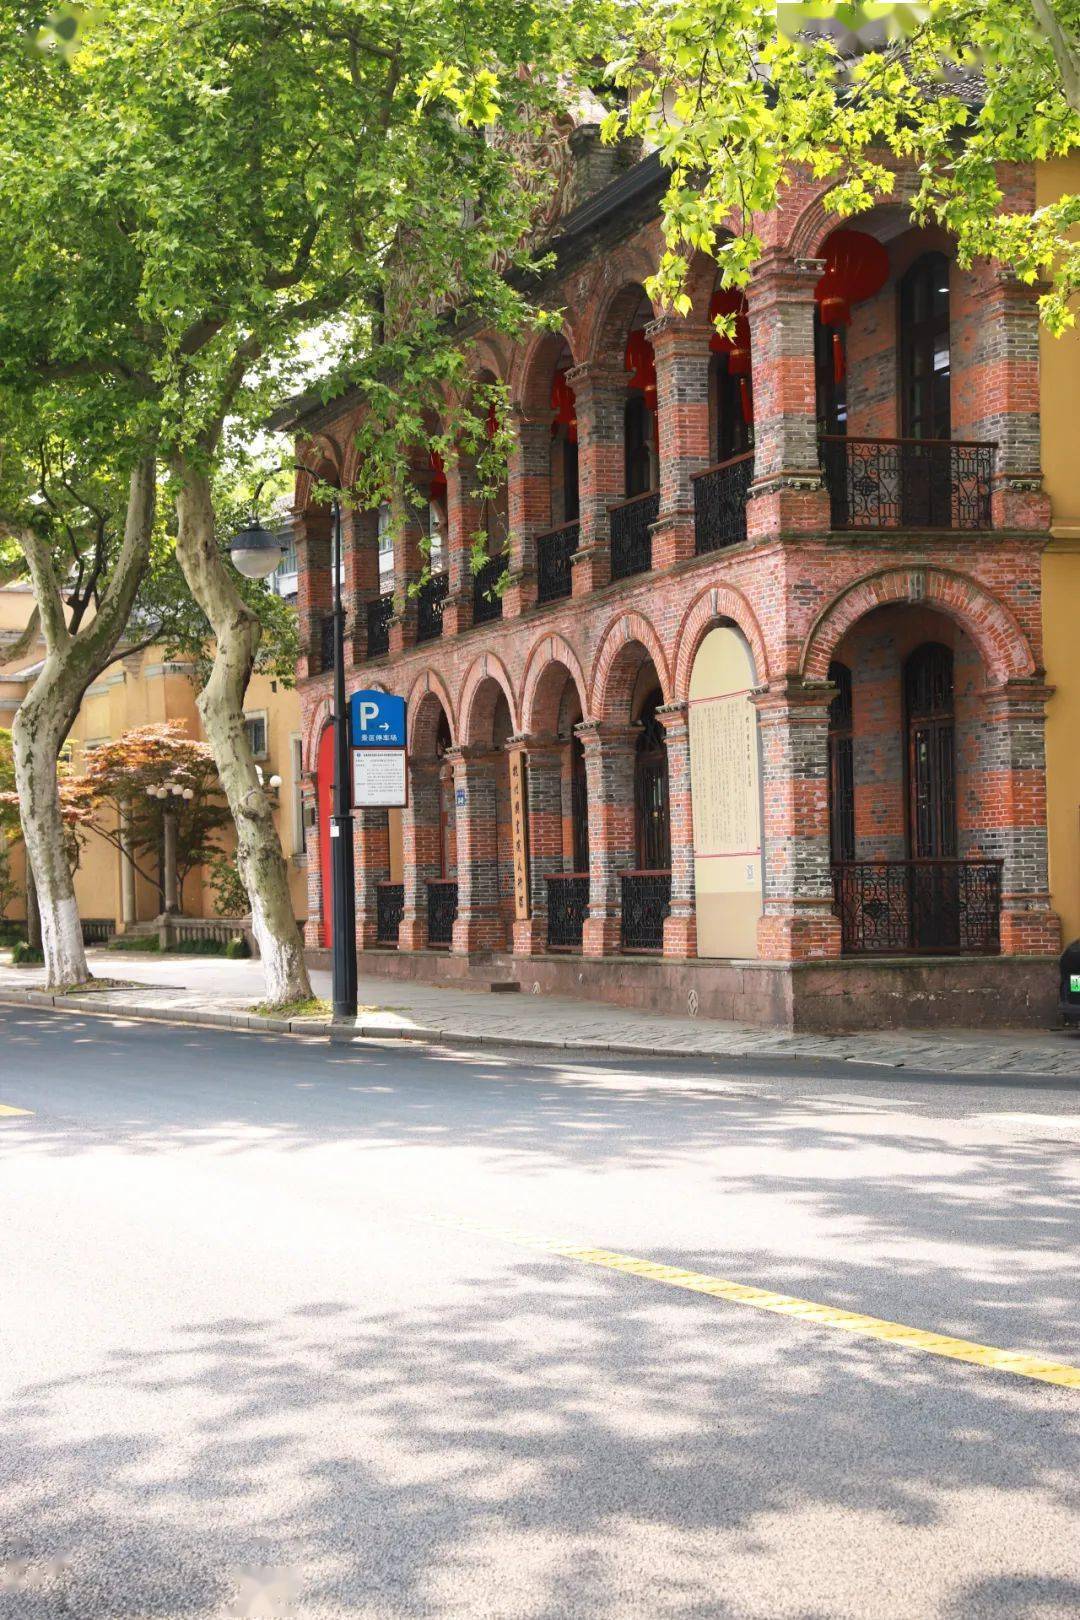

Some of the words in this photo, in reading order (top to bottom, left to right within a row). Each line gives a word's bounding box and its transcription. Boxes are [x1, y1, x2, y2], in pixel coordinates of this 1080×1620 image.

[360, 701, 380, 731] P
[361, 734, 398, 742] 景区停车场
